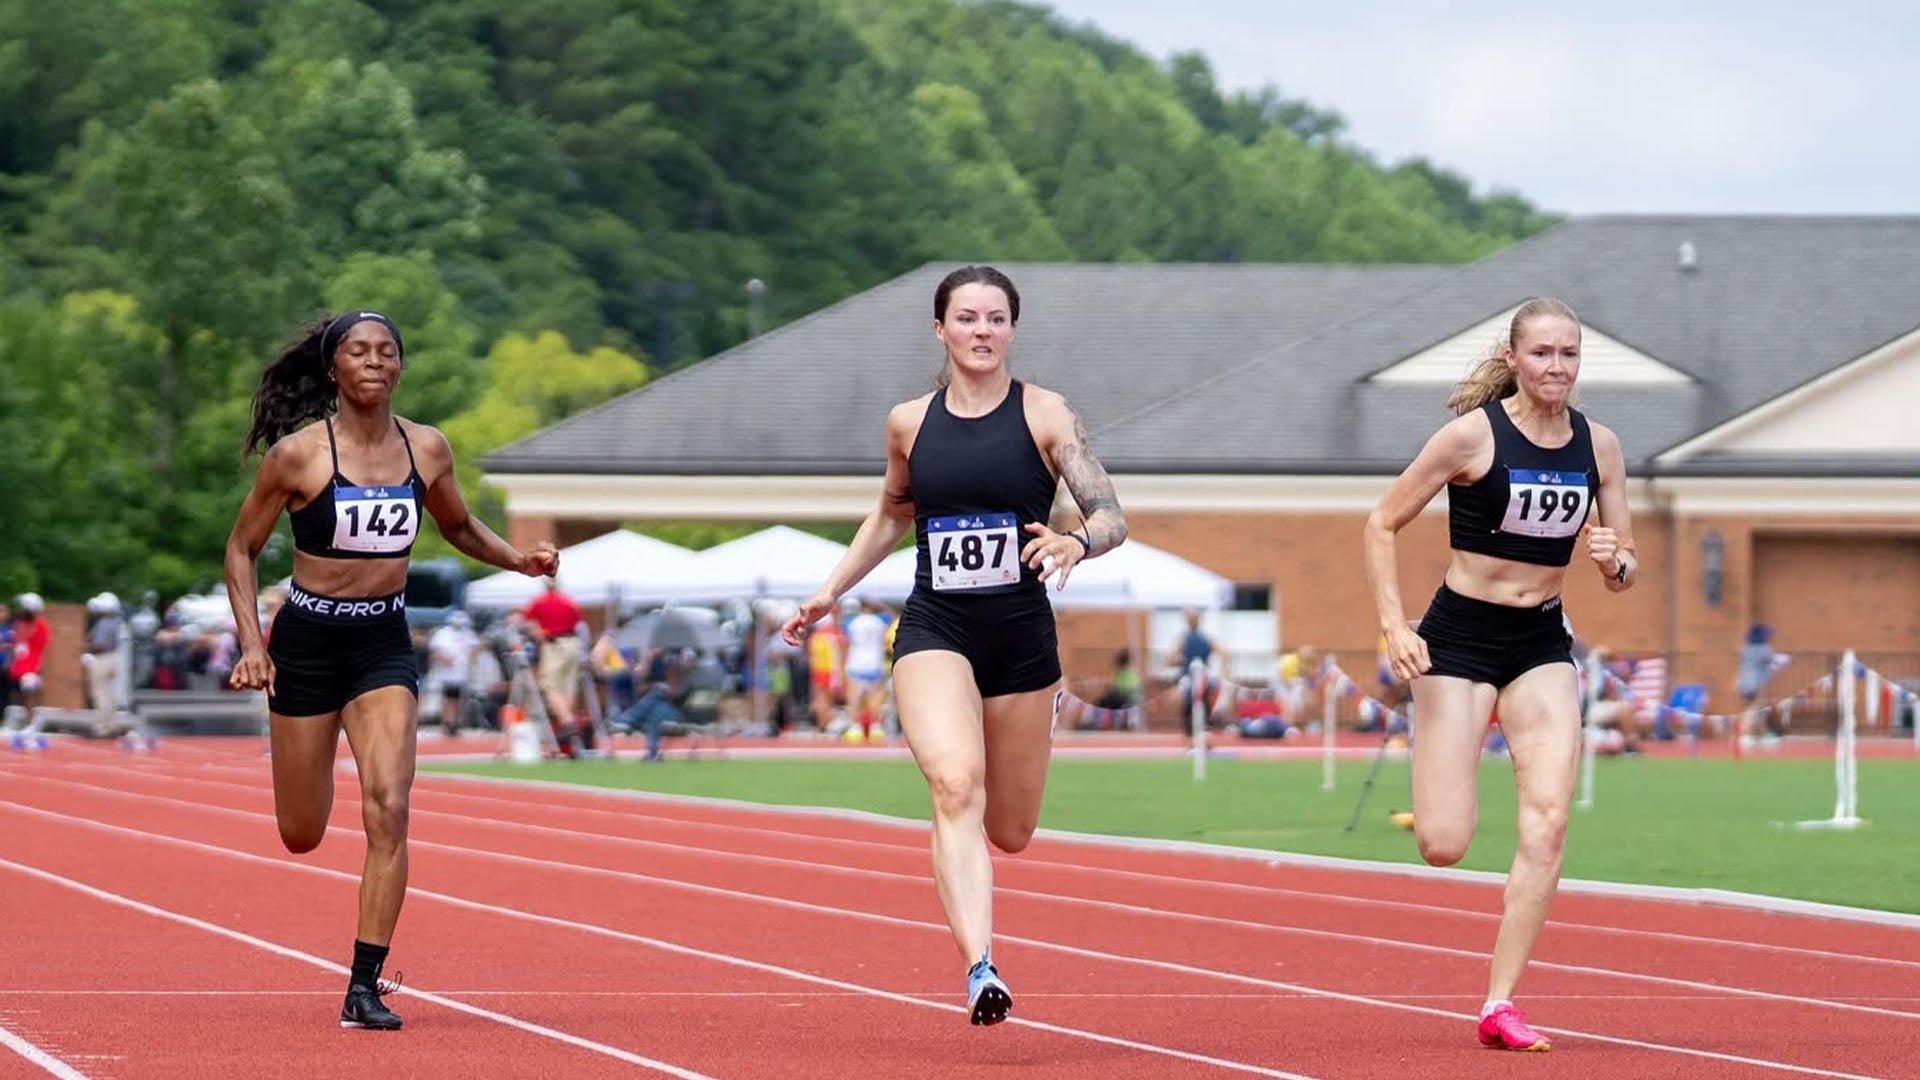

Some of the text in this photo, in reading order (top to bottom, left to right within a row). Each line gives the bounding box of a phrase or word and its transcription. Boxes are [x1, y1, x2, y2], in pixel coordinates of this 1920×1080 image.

[344, 504, 409, 537] 142
[1518, 488, 1580, 523] 199
[938, 533, 1008, 572] 487
[289, 585, 334, 614] NIKE
[334, 601, 386, 617] PRO
